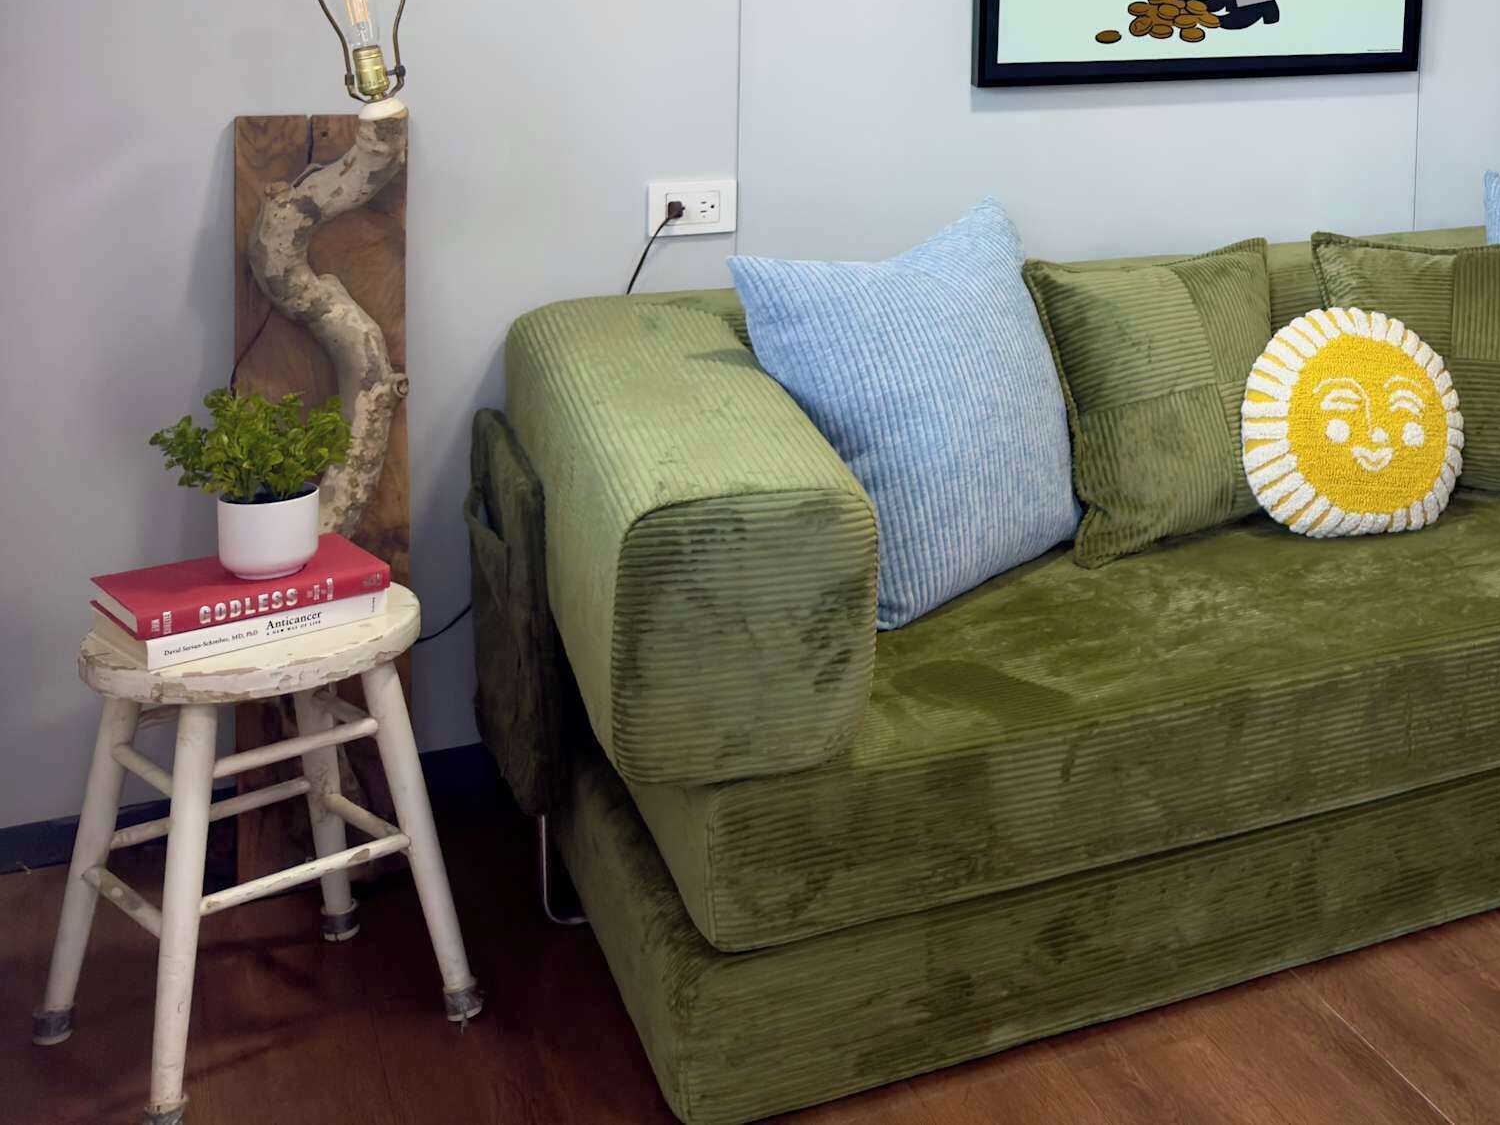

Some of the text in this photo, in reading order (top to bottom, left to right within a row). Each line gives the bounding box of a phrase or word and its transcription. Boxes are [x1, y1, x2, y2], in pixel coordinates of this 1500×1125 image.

[199, 587, 298, 625] GODLESS
[266, 611, 322, 630] Anticancer
[164, 644, 181, 656] David
